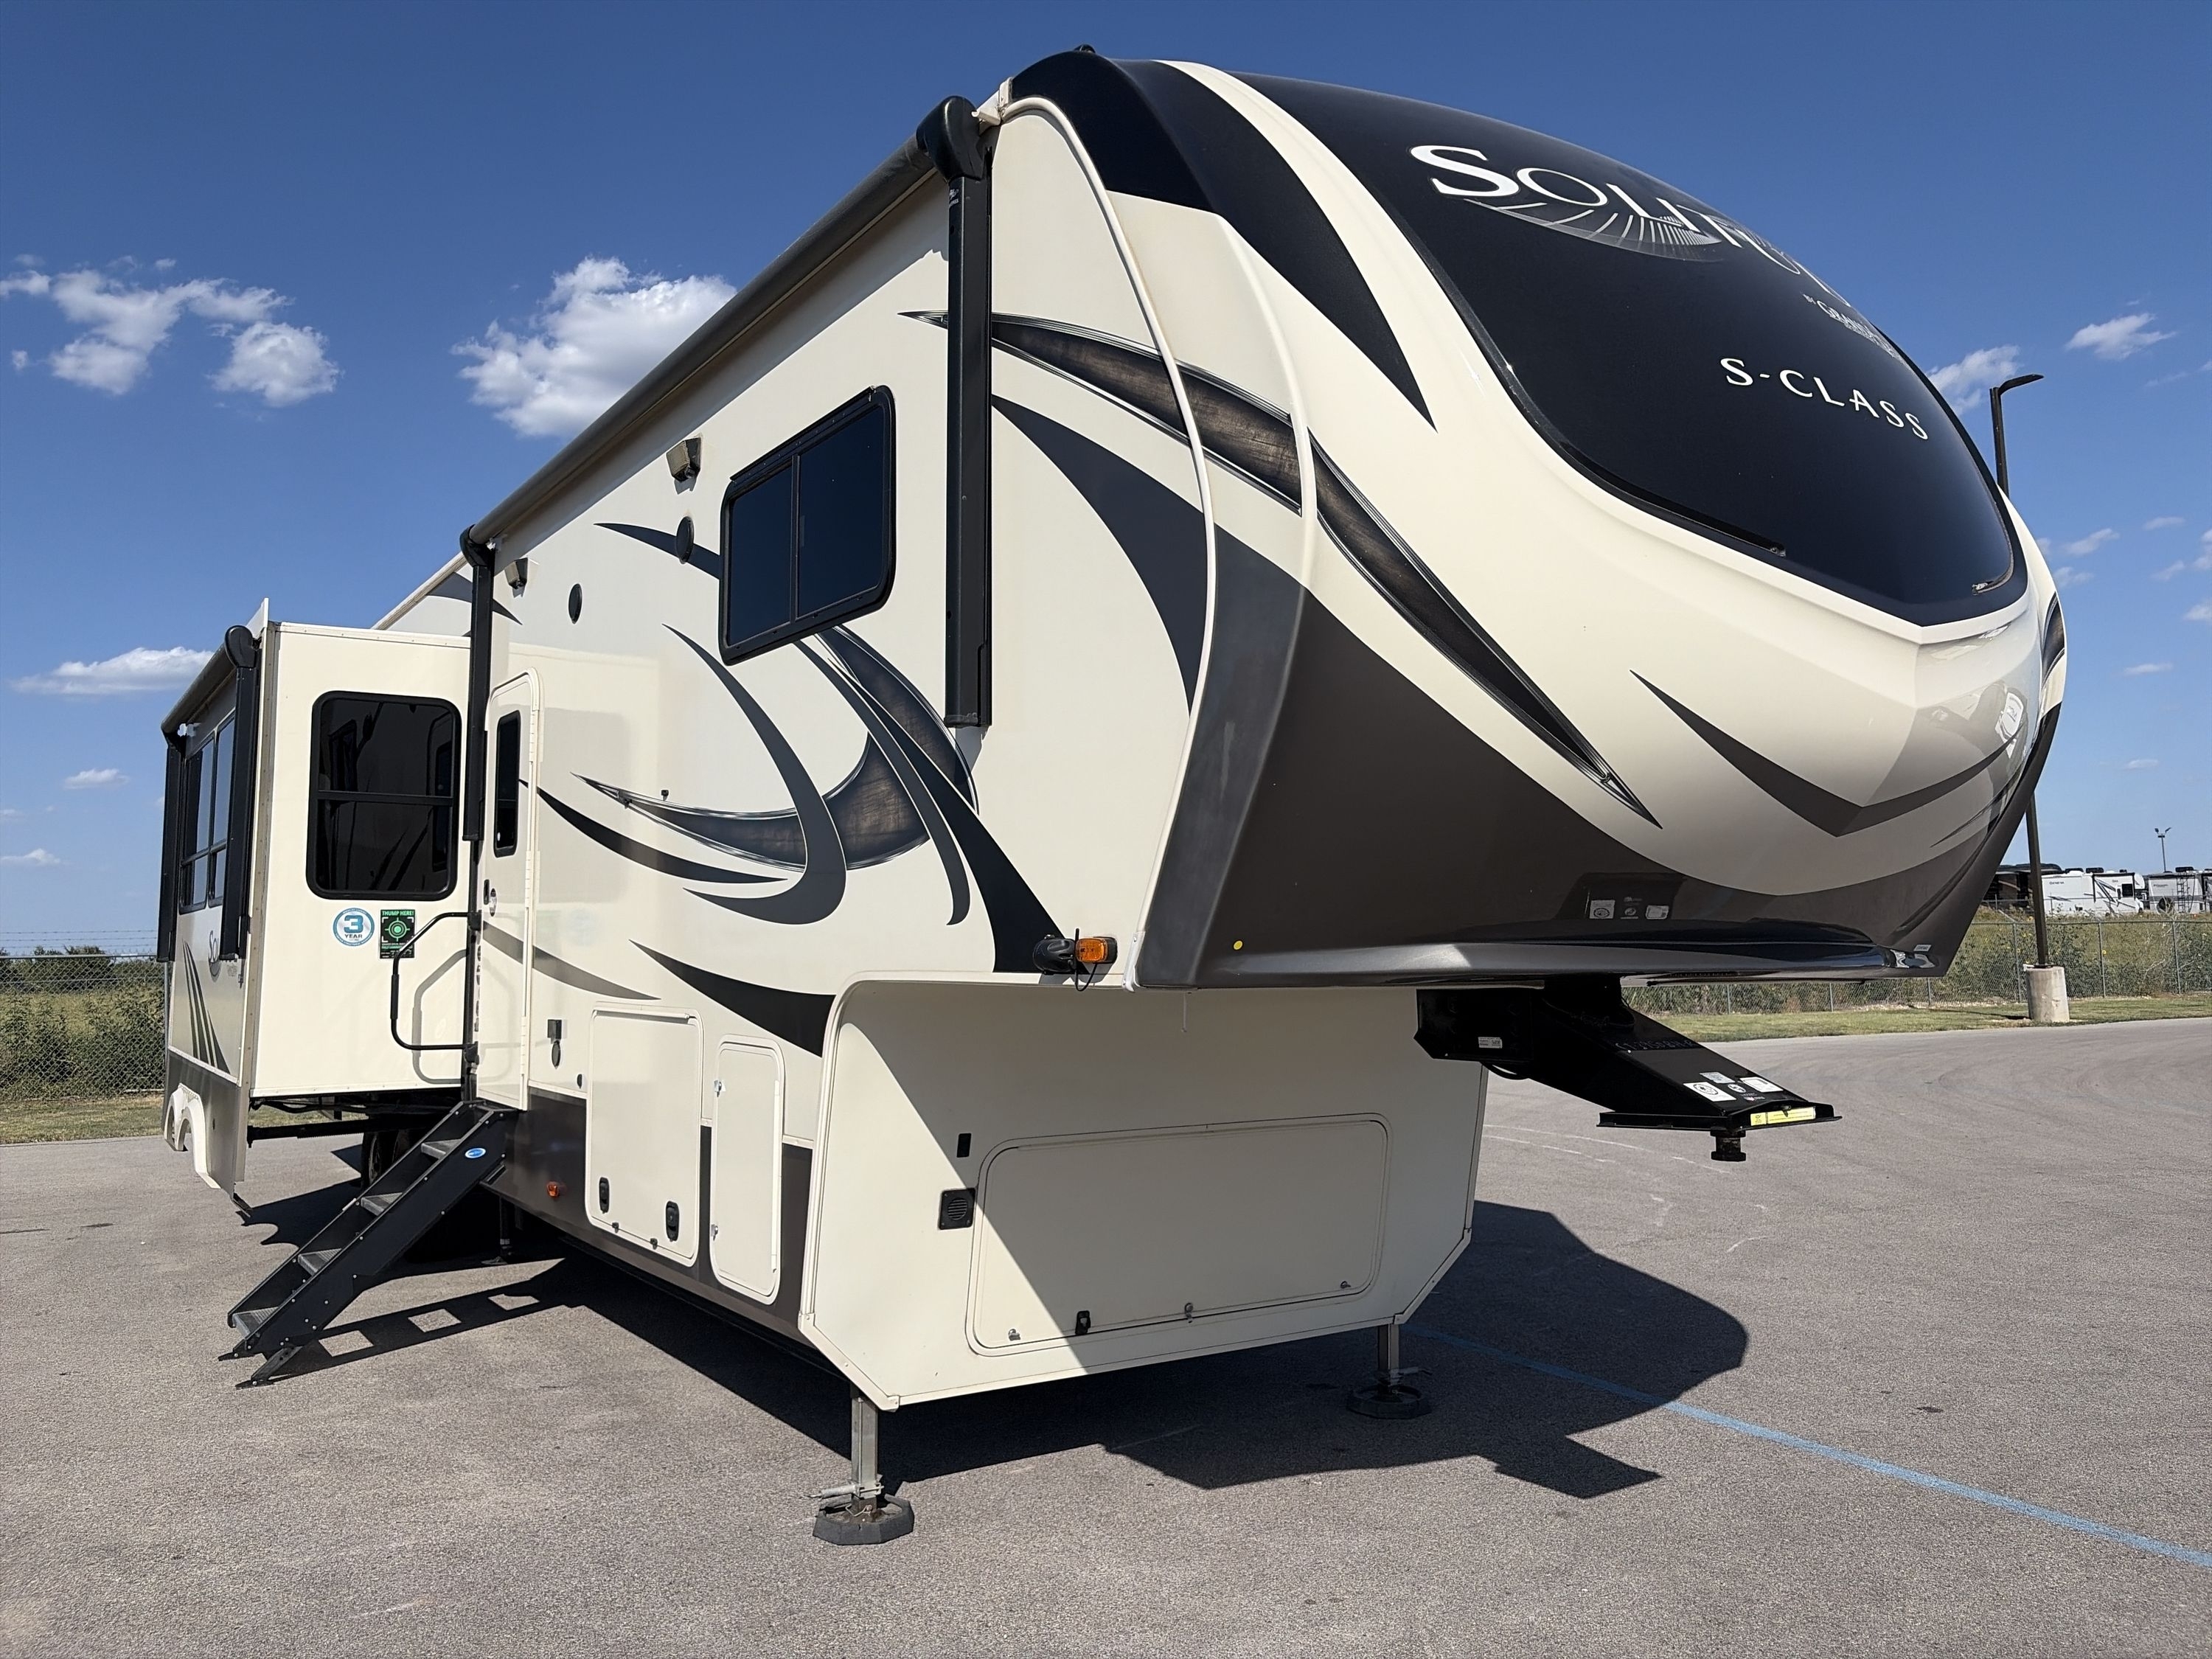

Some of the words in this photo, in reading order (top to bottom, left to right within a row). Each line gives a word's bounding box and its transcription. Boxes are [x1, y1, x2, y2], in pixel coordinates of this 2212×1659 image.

[1411, 145, 1851, 307] SOLITUD
[1720, 358, 1928, 440] S-CLASS
[344, 915, 364, 933] 3
